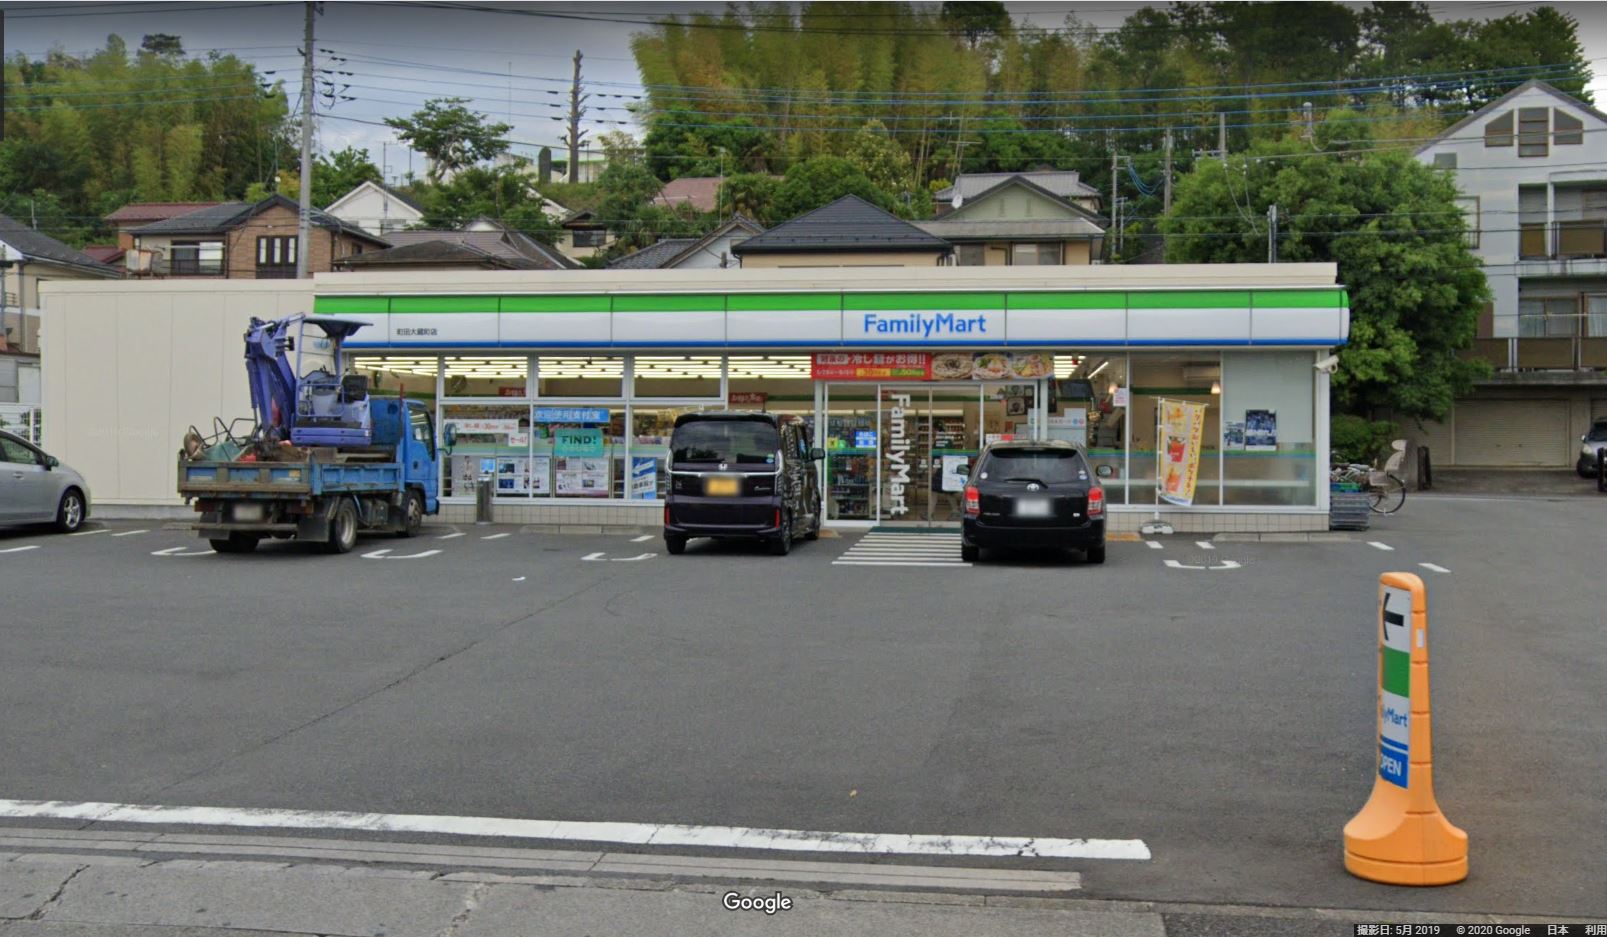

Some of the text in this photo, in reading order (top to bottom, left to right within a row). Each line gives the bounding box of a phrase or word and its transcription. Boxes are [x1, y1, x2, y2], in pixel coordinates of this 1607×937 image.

[864, 313, 986, 338] FamilyMart
[561, 435, 597, 445] FIND!
[886, 394, 910, 515] FamilyMart
